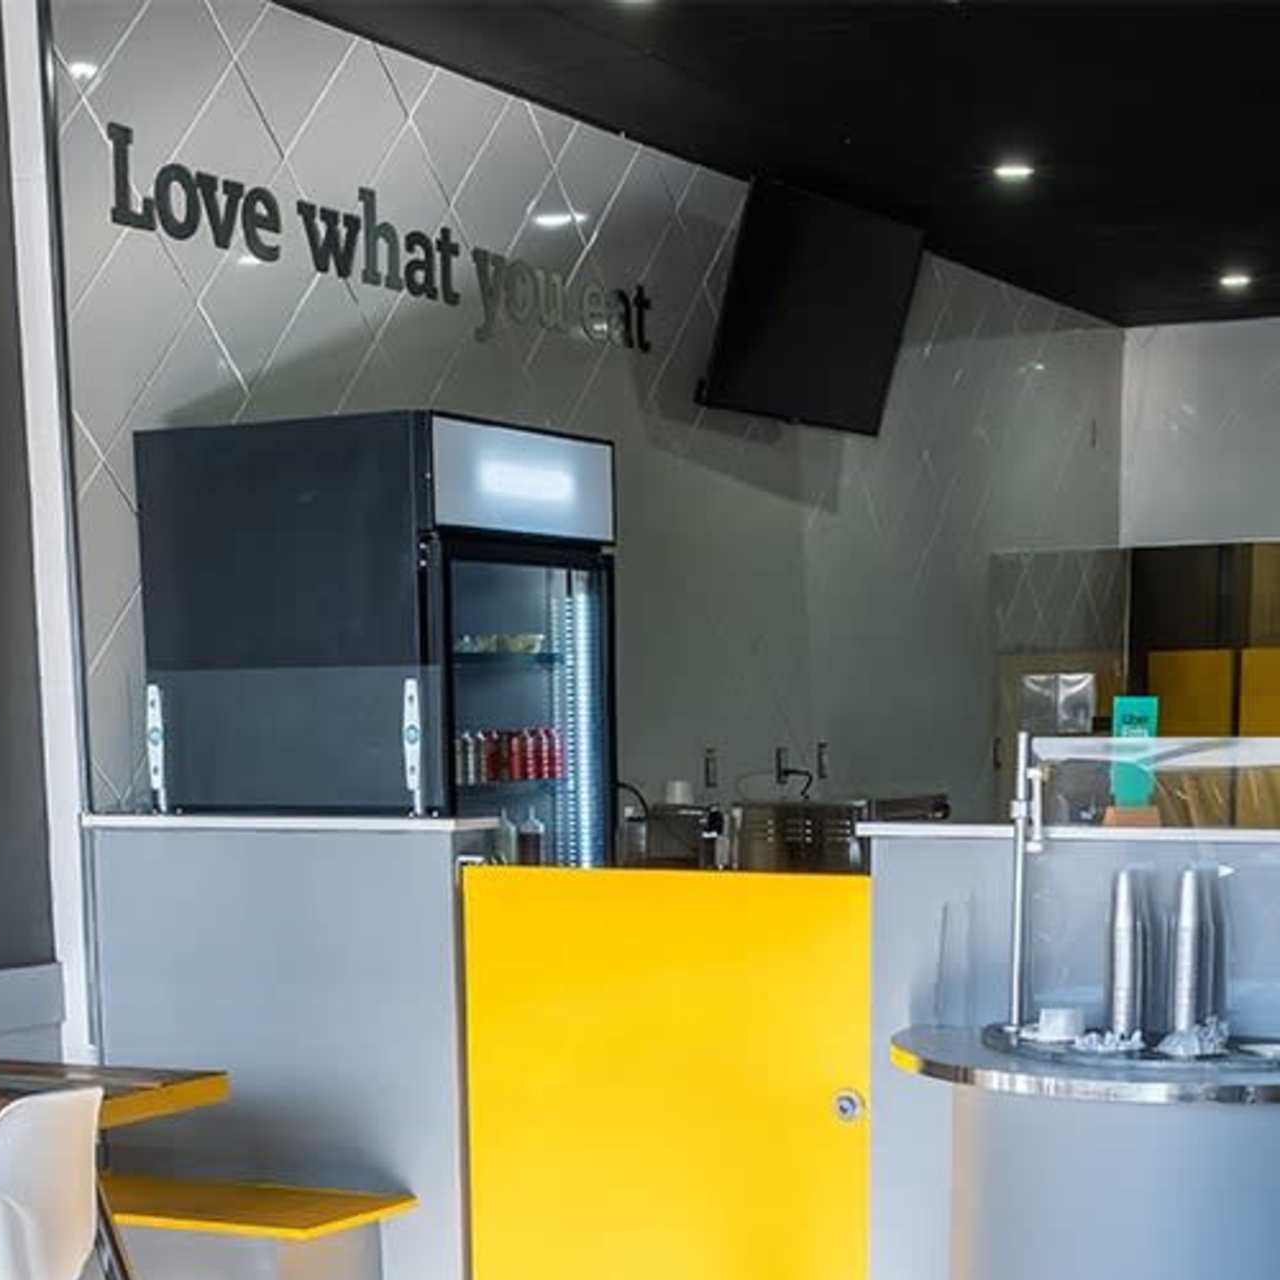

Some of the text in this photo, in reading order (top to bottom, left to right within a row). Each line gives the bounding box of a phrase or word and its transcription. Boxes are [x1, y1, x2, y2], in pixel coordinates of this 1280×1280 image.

[108, 122, 651, 353] Love what you eat
